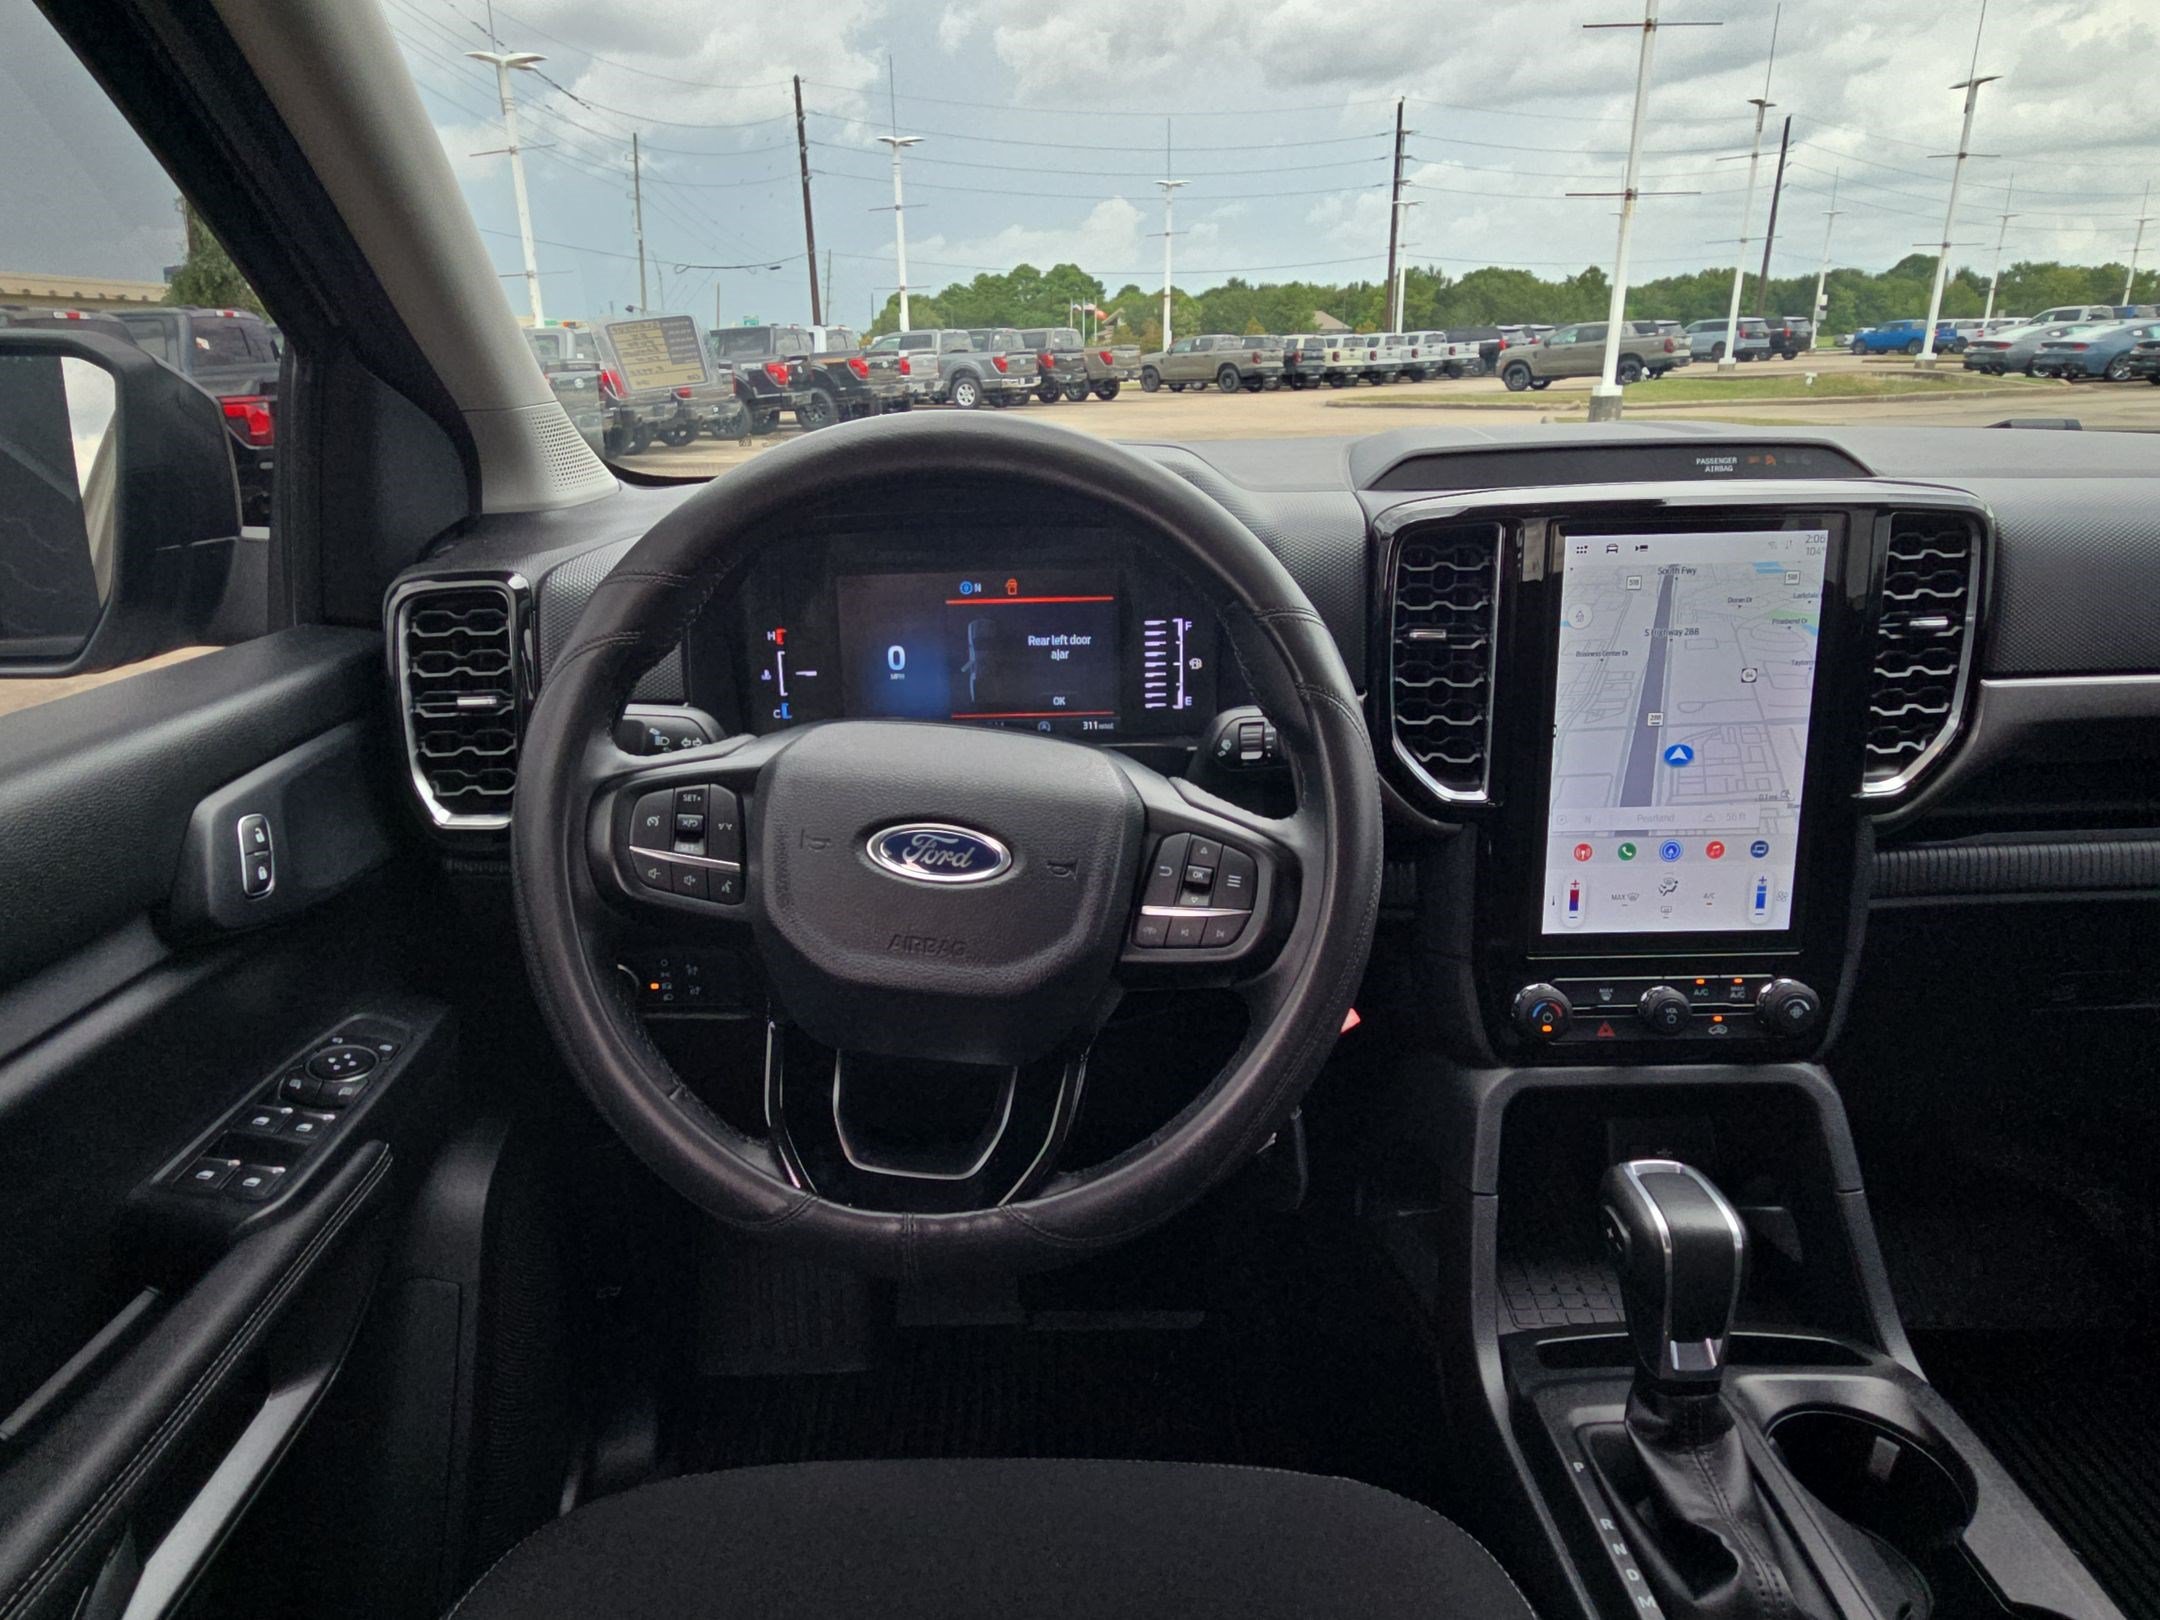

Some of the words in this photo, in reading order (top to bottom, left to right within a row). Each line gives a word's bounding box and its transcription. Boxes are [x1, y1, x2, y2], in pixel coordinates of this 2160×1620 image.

[1696, 456, 1738, 465] PASSENGER
[1704, 465, 1734, 473] AIRBAG
[1805, 534, 1826, 544] 2:06
[1657, 566, 1680, 575] South
[1681, 566, 1697, 576] Fwy
[1185, 621, 1192, 631] F
[767, 631, 776, 641] H
[1027, 635, 1050, 647] Rear
[1051, 634, 1068, 646] left
[1069, 634, 1092, 646] door
[887, 645, 906, 671] 0
[1051, 649, 1069, 661] ajar
[1053, 696, 1066, 706] OK
[1185, 696, 1193, 706] E
[773, 709, 781, 719] C
[1083, 720, 1098, 730] 311
[902, 833, 976, 869] Ford
[1192, 871, 1204, 880] OK
[887, 934, 967, 957] AIRBAG
[1693, 988, 1709, 996] A/C
[1729, 991, 1745, 999] A/C
[1572, 1461, 1585, 1473] P
[1600, 1518, 1615, 1530] R
[1612, 1543, 1628, 1555] N
[1625, 1568, 1640, 1581] D
[1637, 1595, 1658, 1609] M
